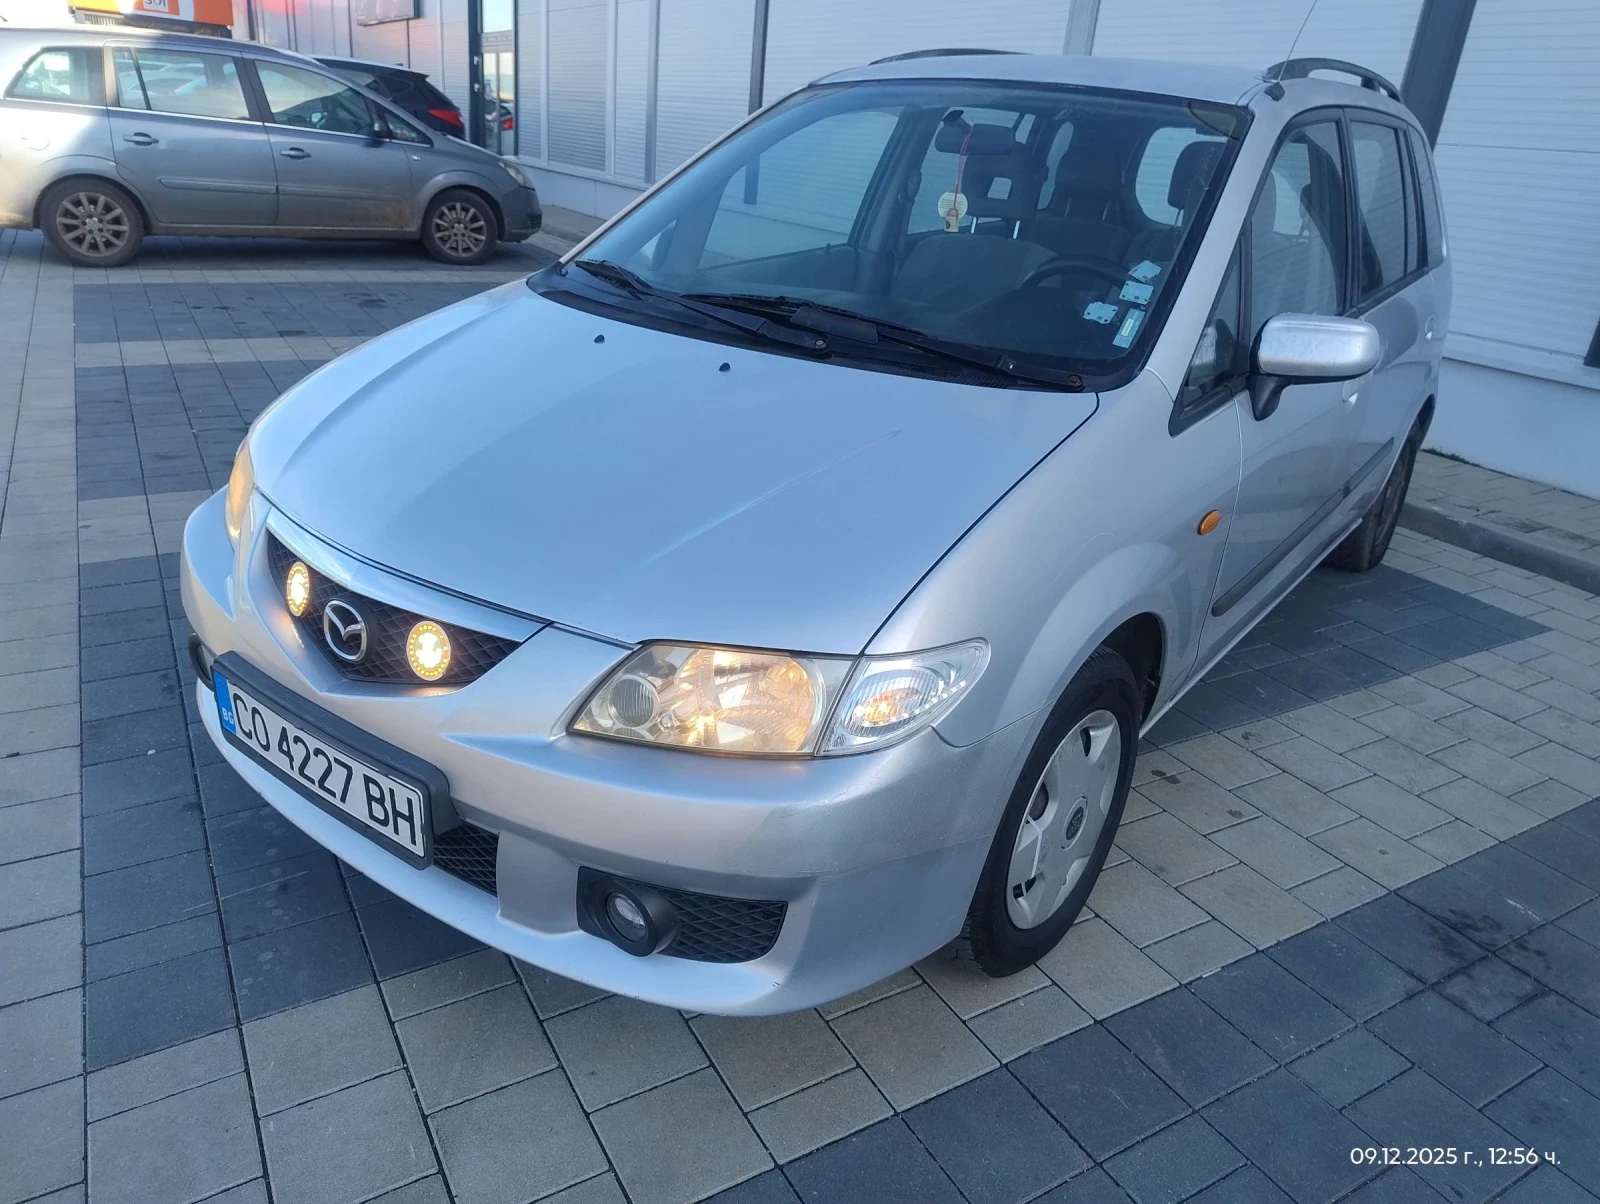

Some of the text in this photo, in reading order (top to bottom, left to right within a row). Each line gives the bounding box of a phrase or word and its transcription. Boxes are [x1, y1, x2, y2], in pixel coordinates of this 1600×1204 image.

[222, 706, 234, 725] BG
[233, 693, 416, 846] CO 4227 BH
